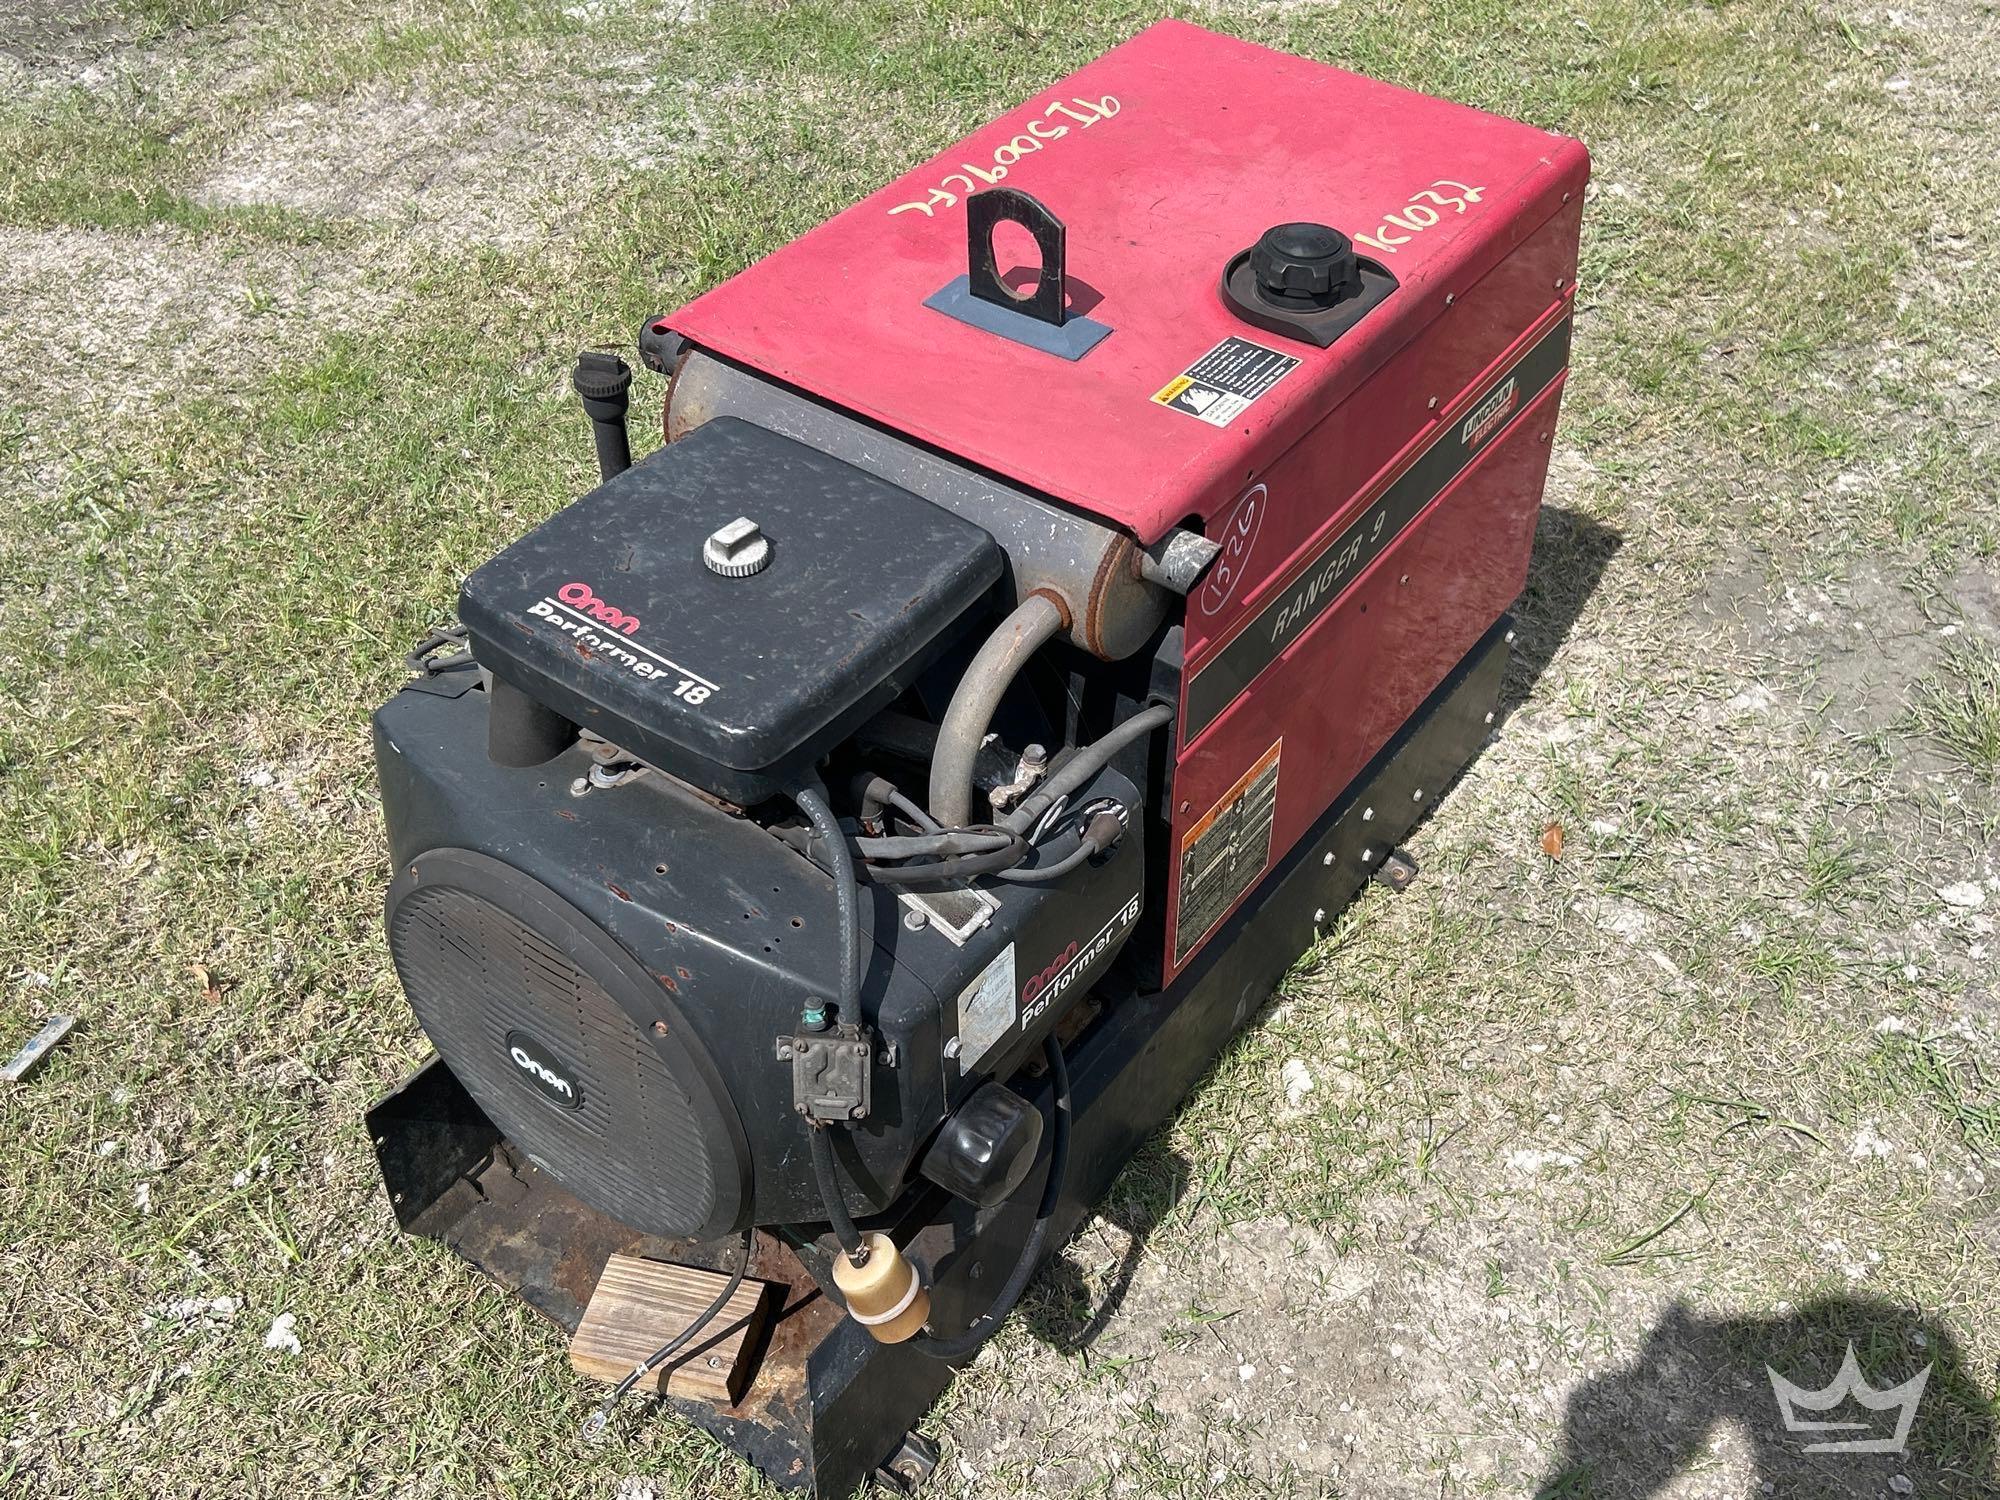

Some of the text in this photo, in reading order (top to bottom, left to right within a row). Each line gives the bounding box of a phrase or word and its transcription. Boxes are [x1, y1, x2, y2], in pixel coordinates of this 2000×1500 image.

[1353, 180, 1487, 254] K1032
[1462, 377, 1515, 444] LINCOLN
[1210, 500, 1256, 597] 1526
[1271, 509, 1387, 643] RANGER 9
[557, 582, 641, 636] Onan
[526, 600, 712, 706] Performer 18
[1021, 899, 1140, 1032] Performer 18
[1021, 939, 1079, 1003] Onan
[510, 1046, 573, 1098] Onan
